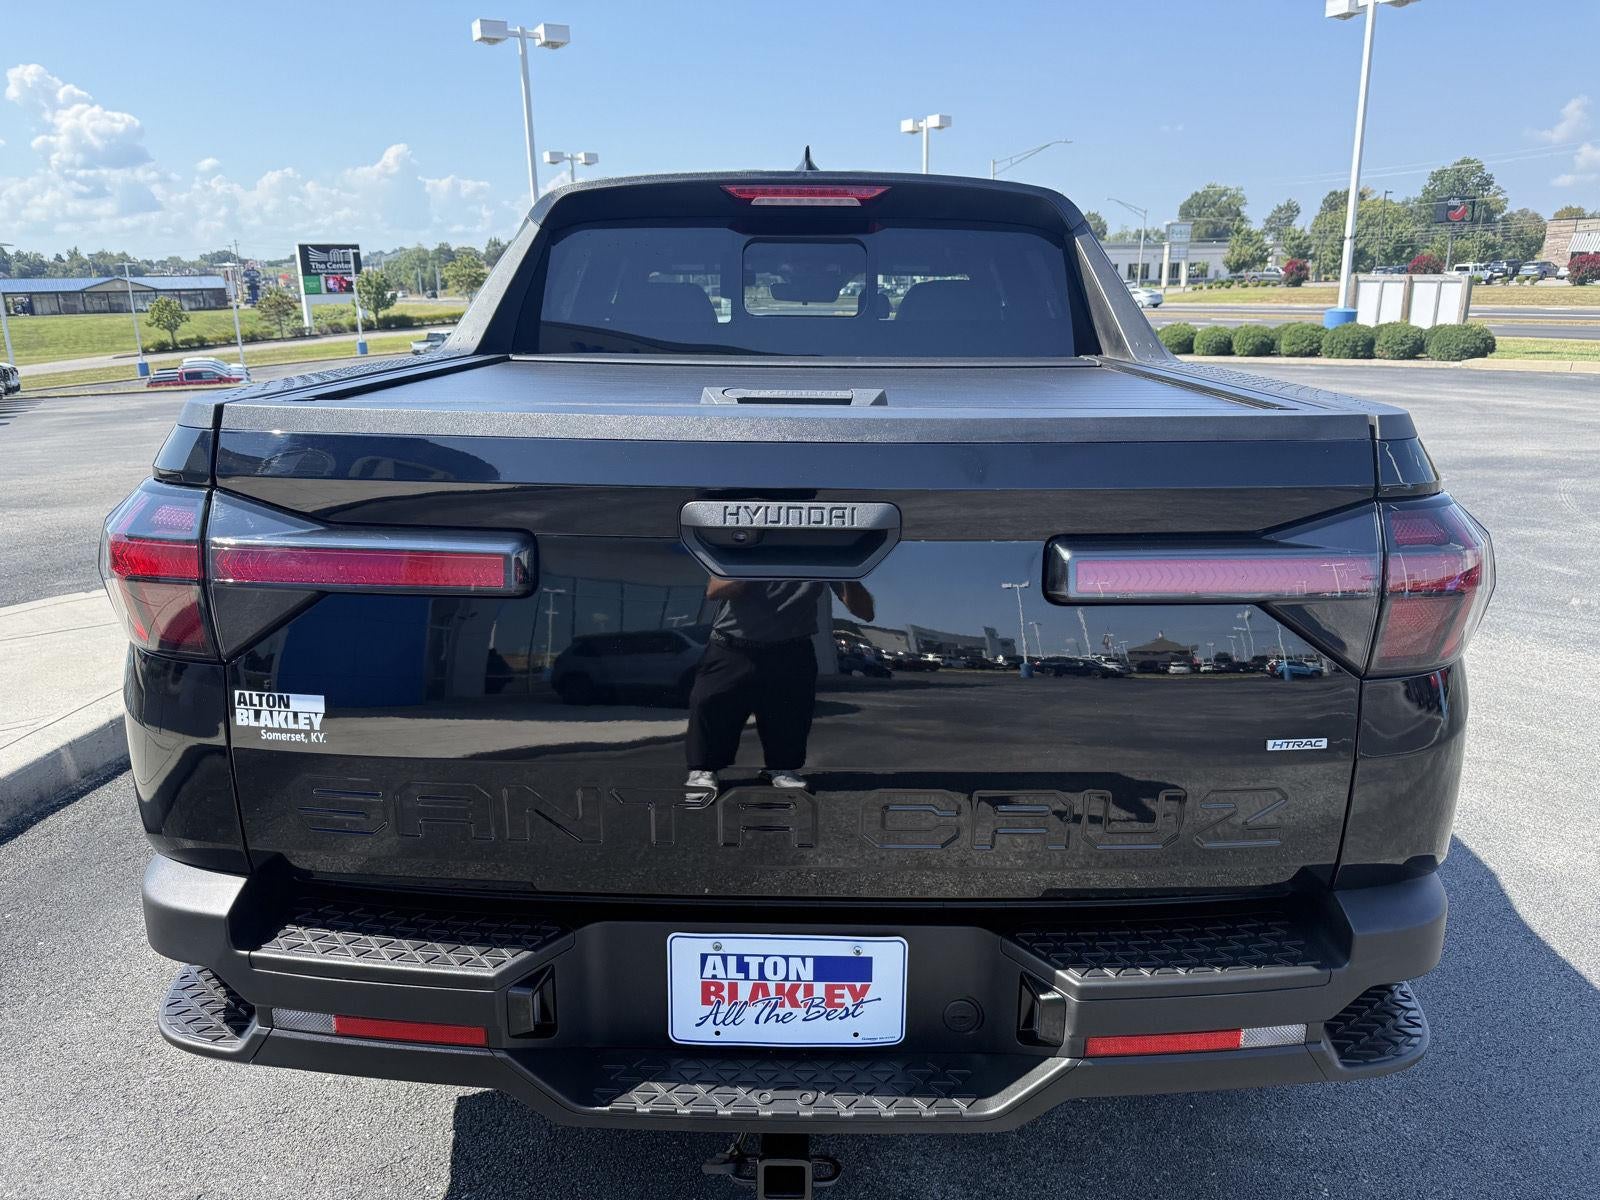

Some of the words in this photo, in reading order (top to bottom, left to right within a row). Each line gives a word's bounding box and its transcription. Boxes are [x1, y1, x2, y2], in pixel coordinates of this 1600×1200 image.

[723, 505, 857, 526] HYUNDAI
[236, 692, 291, 710] ALTON
[235, 708, 324, 731] BLAKLEY
[261, 729, 308, 743] Somerset,
[311, 732, 327, 743] KY.
[1272, 739, 1324, 749] HTRAC
[298, 776, 817, 848] SANTA
[861, 787, 1288, 849] CRUZ
[701, 955, 814, 981] ALTON
[700, 980, 871, 1009] BLAKLEY
[695, 999, 749, 1027] All
[751, 996, 797, 1025] The
[800, 996, 881, 1022] Best
